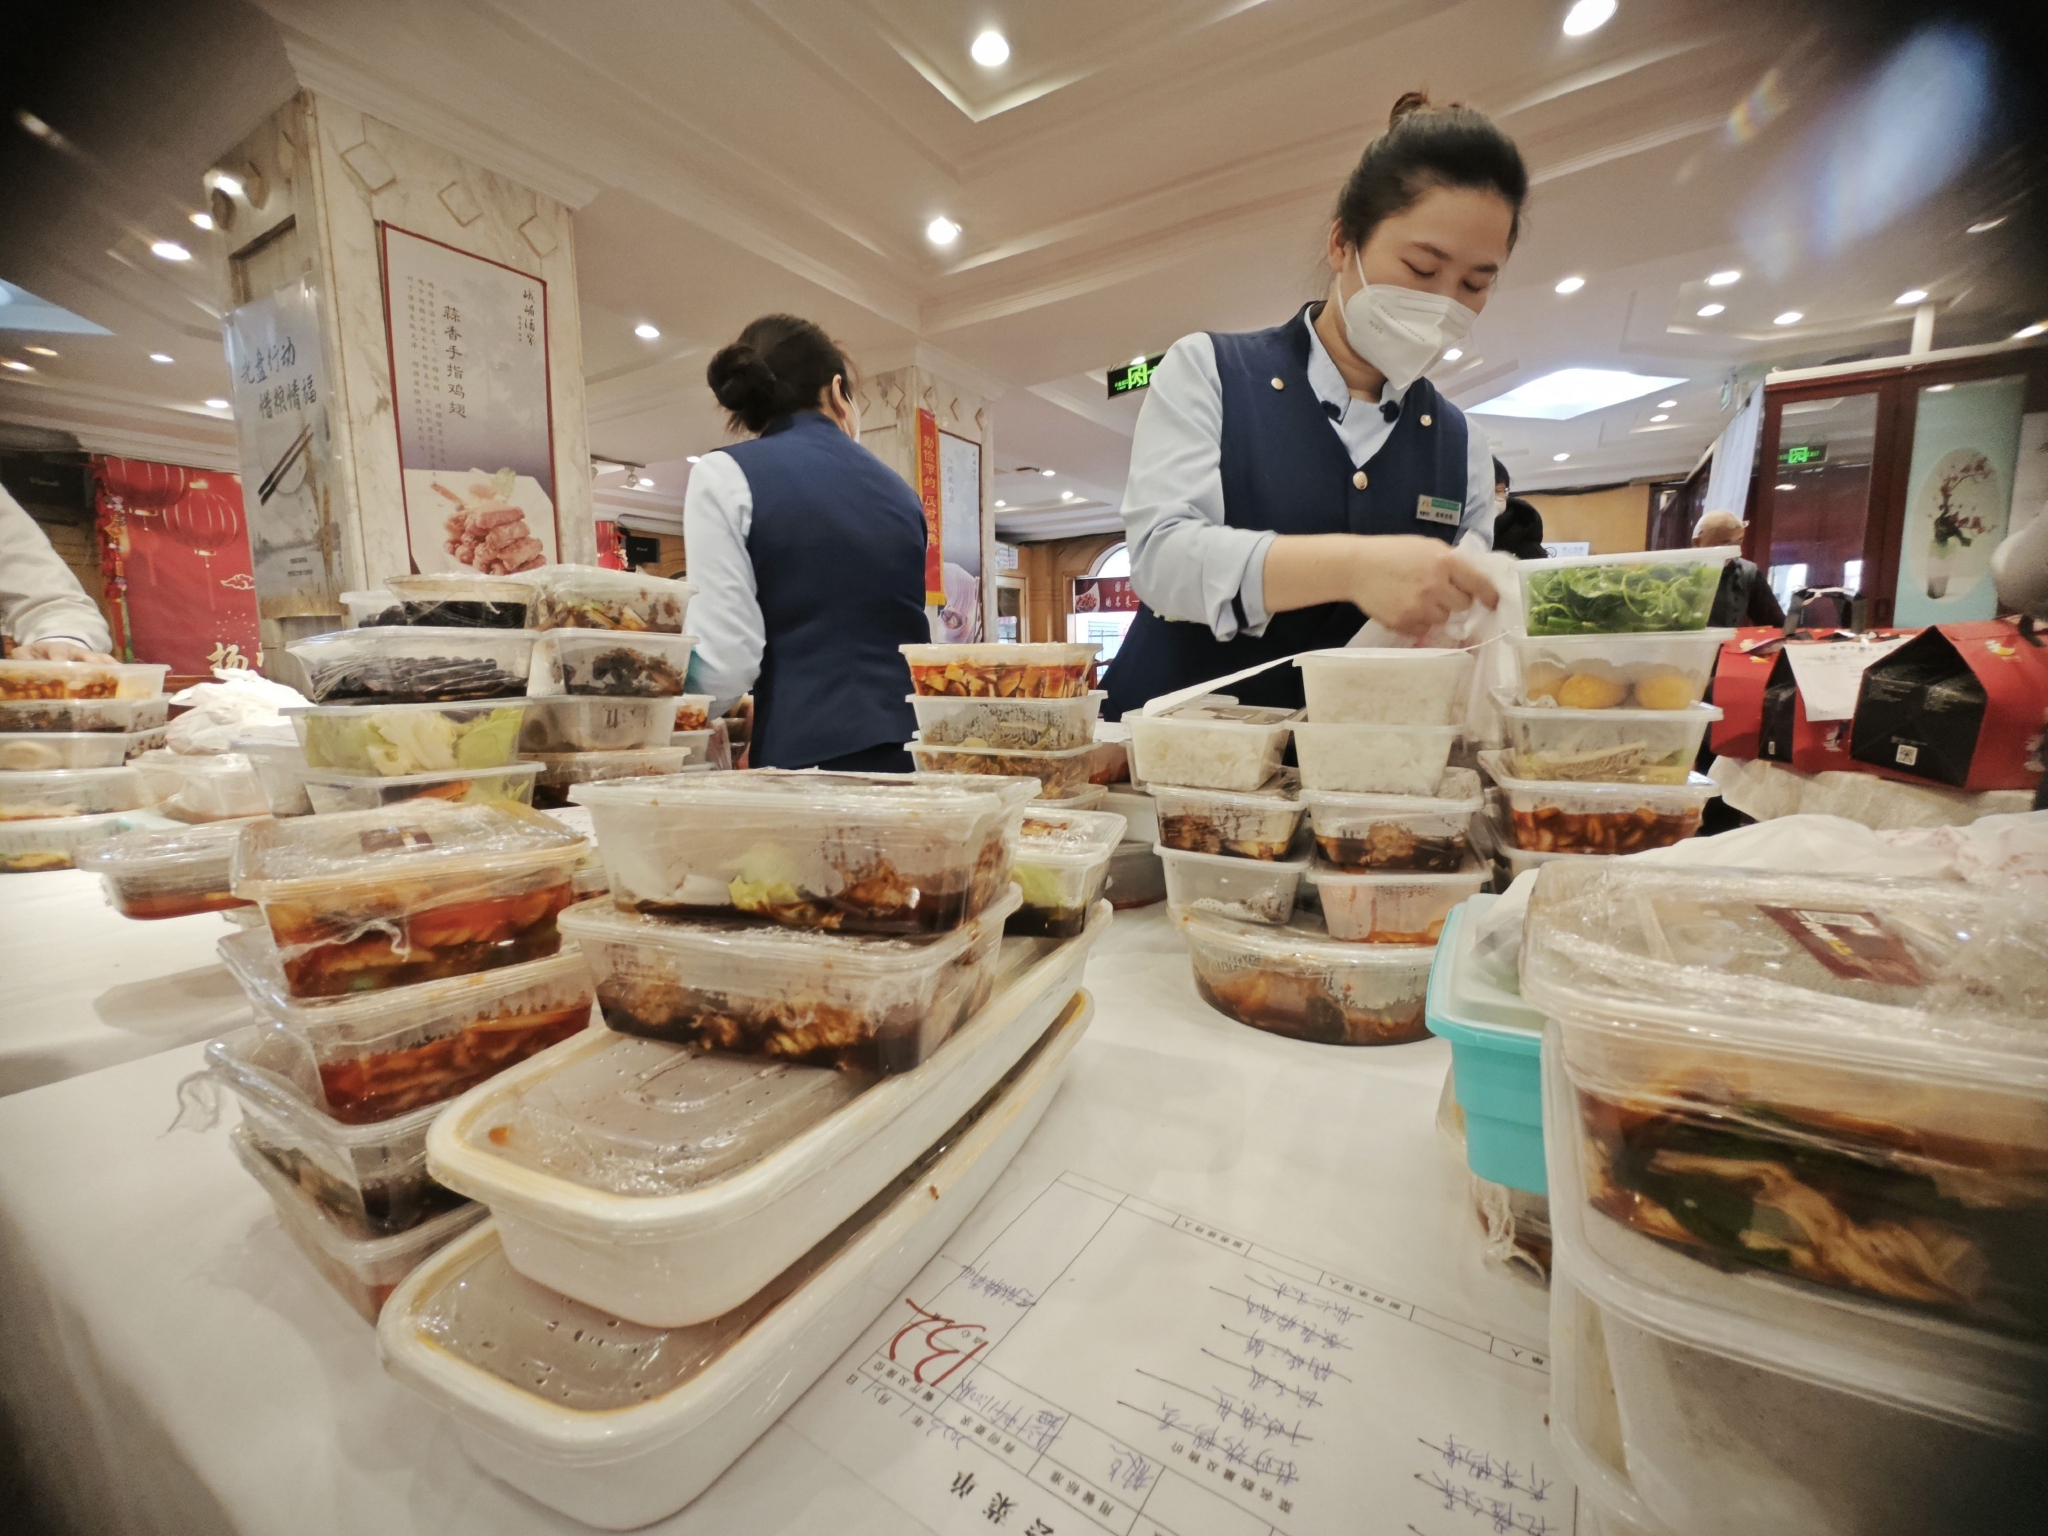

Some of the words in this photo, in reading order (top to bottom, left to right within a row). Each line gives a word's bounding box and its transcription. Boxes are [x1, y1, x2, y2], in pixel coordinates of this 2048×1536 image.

[240, 336, 295, 384] 光盘行动
[443, 304, 467, 419] 蒜香手指鸡翅
[923, 436, 936, 489] 勤俭节约
[873, 1360, 935, 1402] 餐厅及座位
[960, 1413, 1017, 1455] 有何要求
[1050, 1470, 1114, 1517] 用餐标准
[1171, 1441, 1294, 1515] 菜名数量及售价
